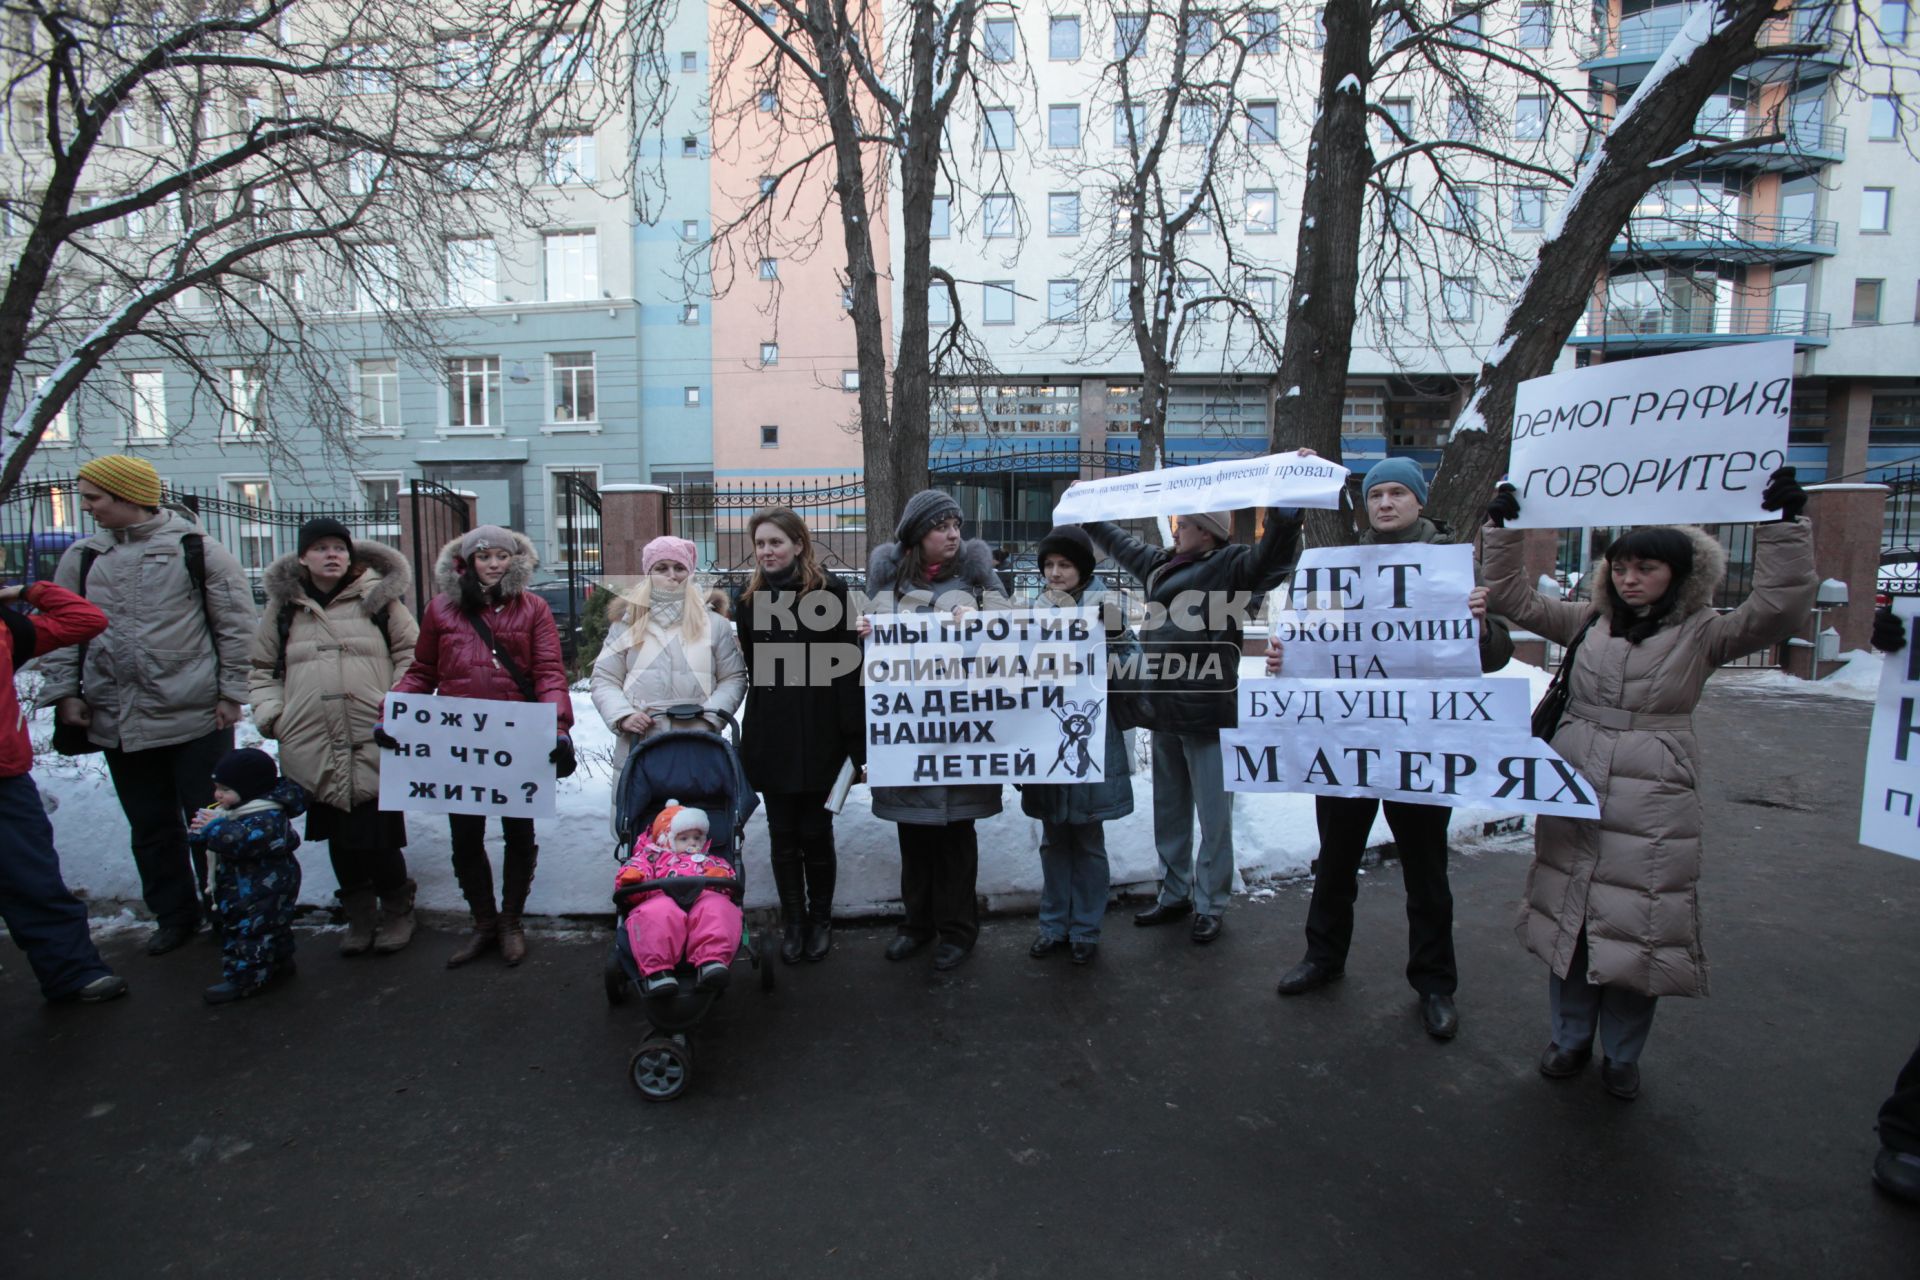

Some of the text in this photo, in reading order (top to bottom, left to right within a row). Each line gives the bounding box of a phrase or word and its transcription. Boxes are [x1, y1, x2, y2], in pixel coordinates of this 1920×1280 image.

[1274, 463, 1334, 482] провал
[1283, 563, 1422, 611] НЕТ
[873, 618, 1090, 647] МЫ ПРОТИВ
[867, 652, 1095, 683] ОЛИМПИАДЫ
[1331, 654, 1388, 679] НА
[871, 685, 1065, 718] ЗА ДЕНЬГИ
[870, 720, 996, 746] НАШИХ
[393, 742, 513, 767] на что
[913, 748, 1036, 783] ДЕТЕЙ
